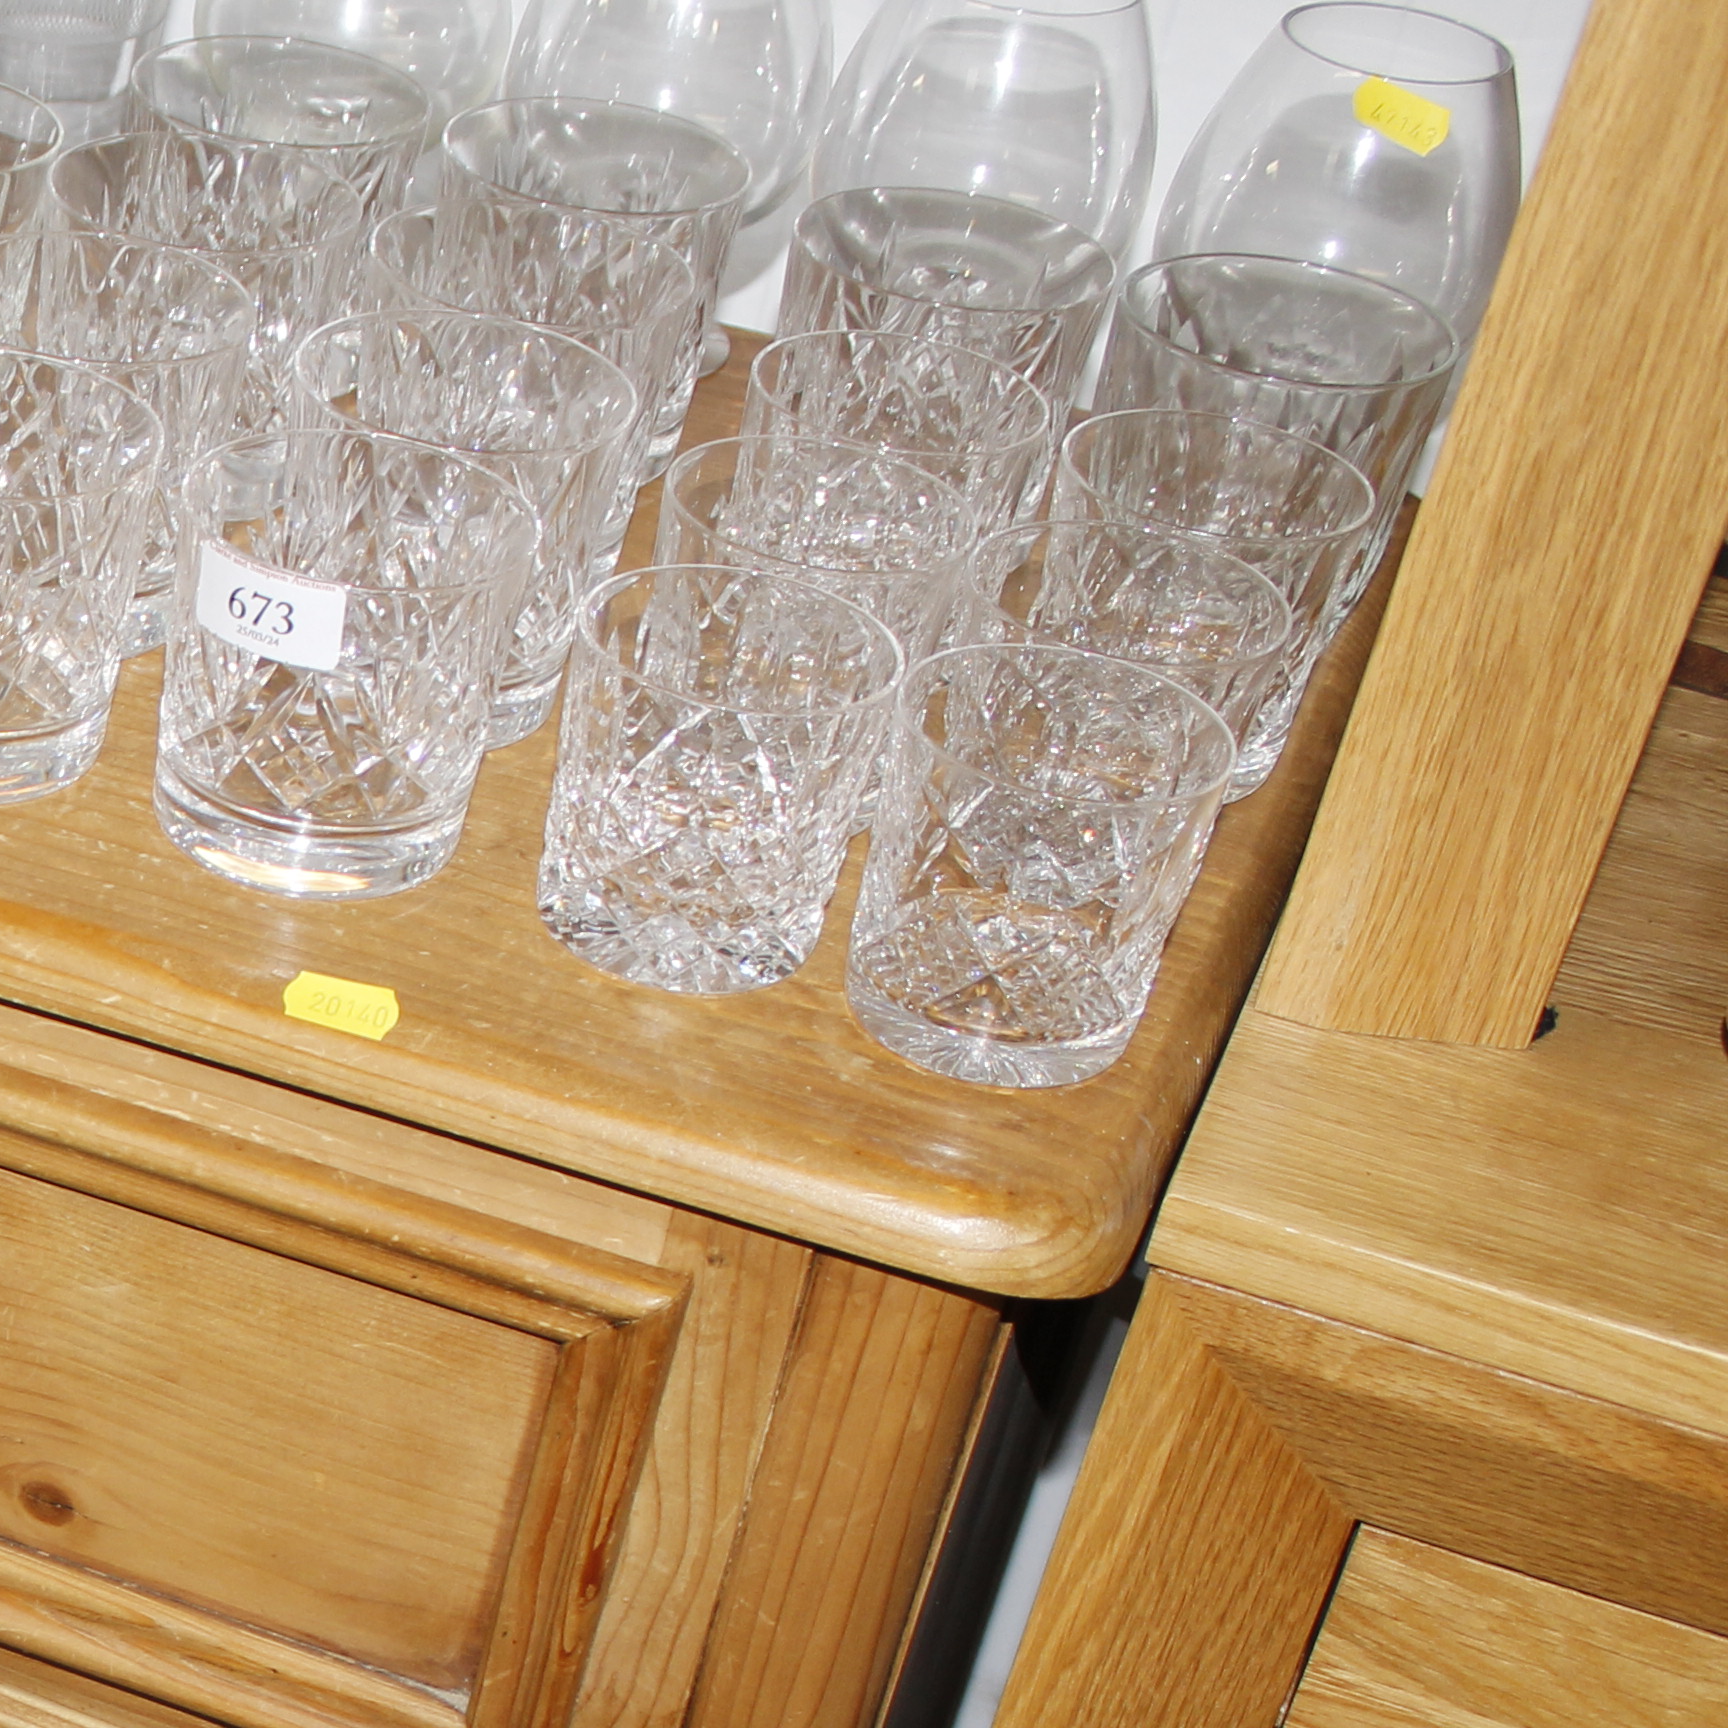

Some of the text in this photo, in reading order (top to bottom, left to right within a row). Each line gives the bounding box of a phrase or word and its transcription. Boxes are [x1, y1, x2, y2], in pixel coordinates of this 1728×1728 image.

[291, 575, 337, 592] Auctions
[228, 586, 294, 635] 673
[236, 624, 281, 647] 25/03/24
[308, 991, 389, 1028] 20140
